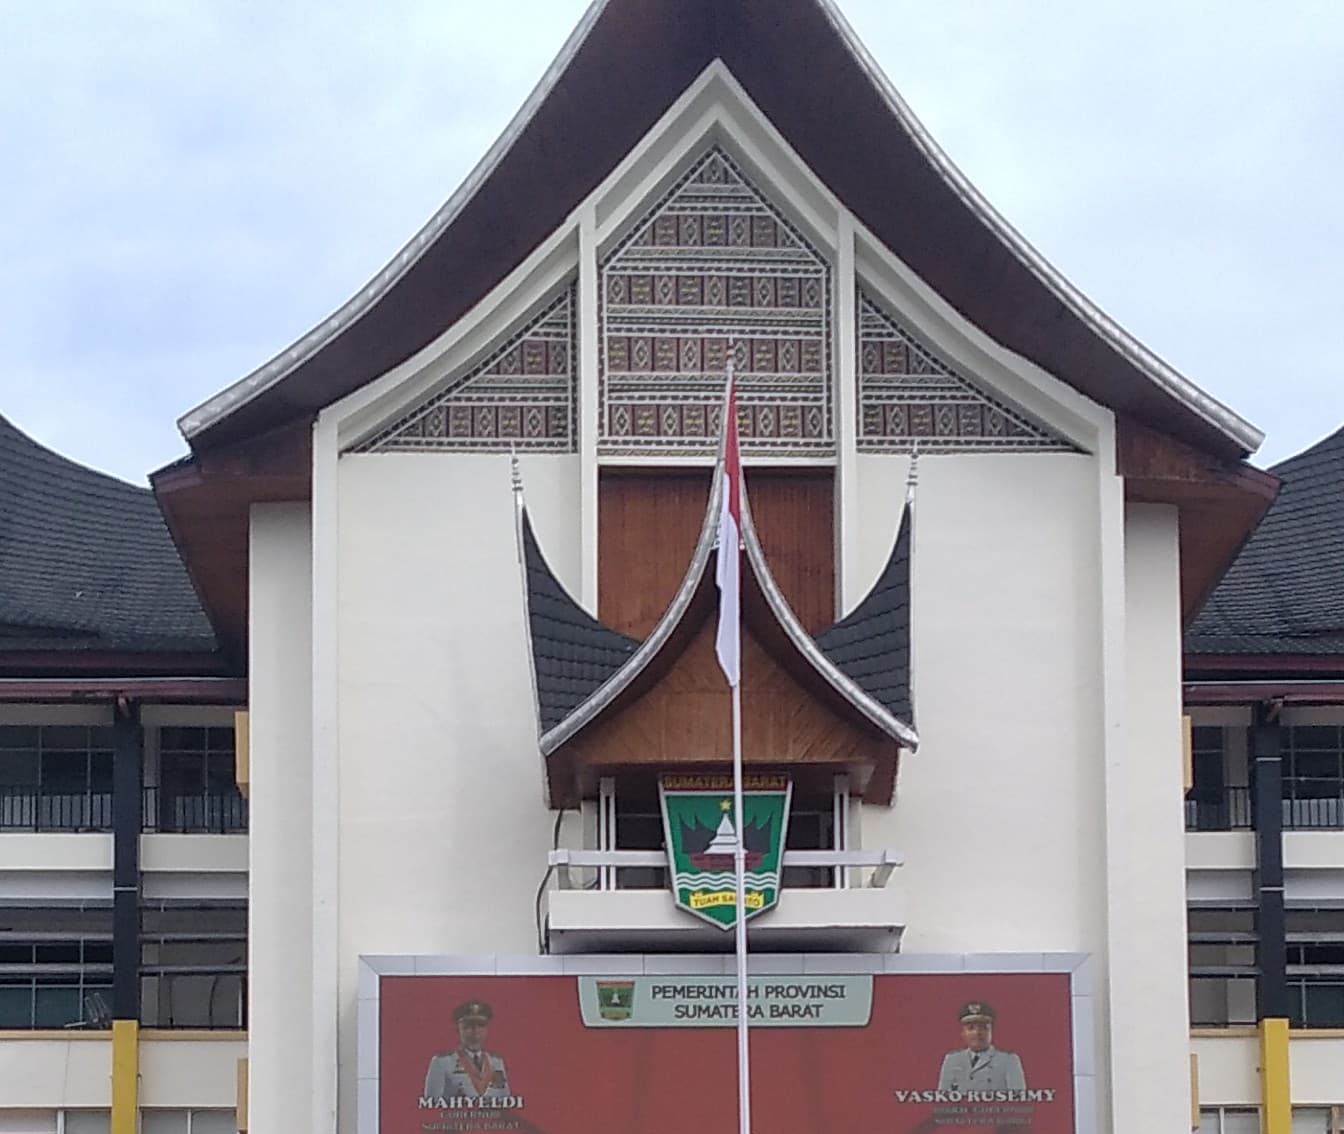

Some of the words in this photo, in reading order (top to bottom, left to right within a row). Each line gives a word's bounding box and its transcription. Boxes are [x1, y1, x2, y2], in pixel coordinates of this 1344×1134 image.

[765, 984, 846, 999] PROVINSI
[769, 1004, 824, 1019] BARAT
[895, 1089, 963, 1103] VASKO
